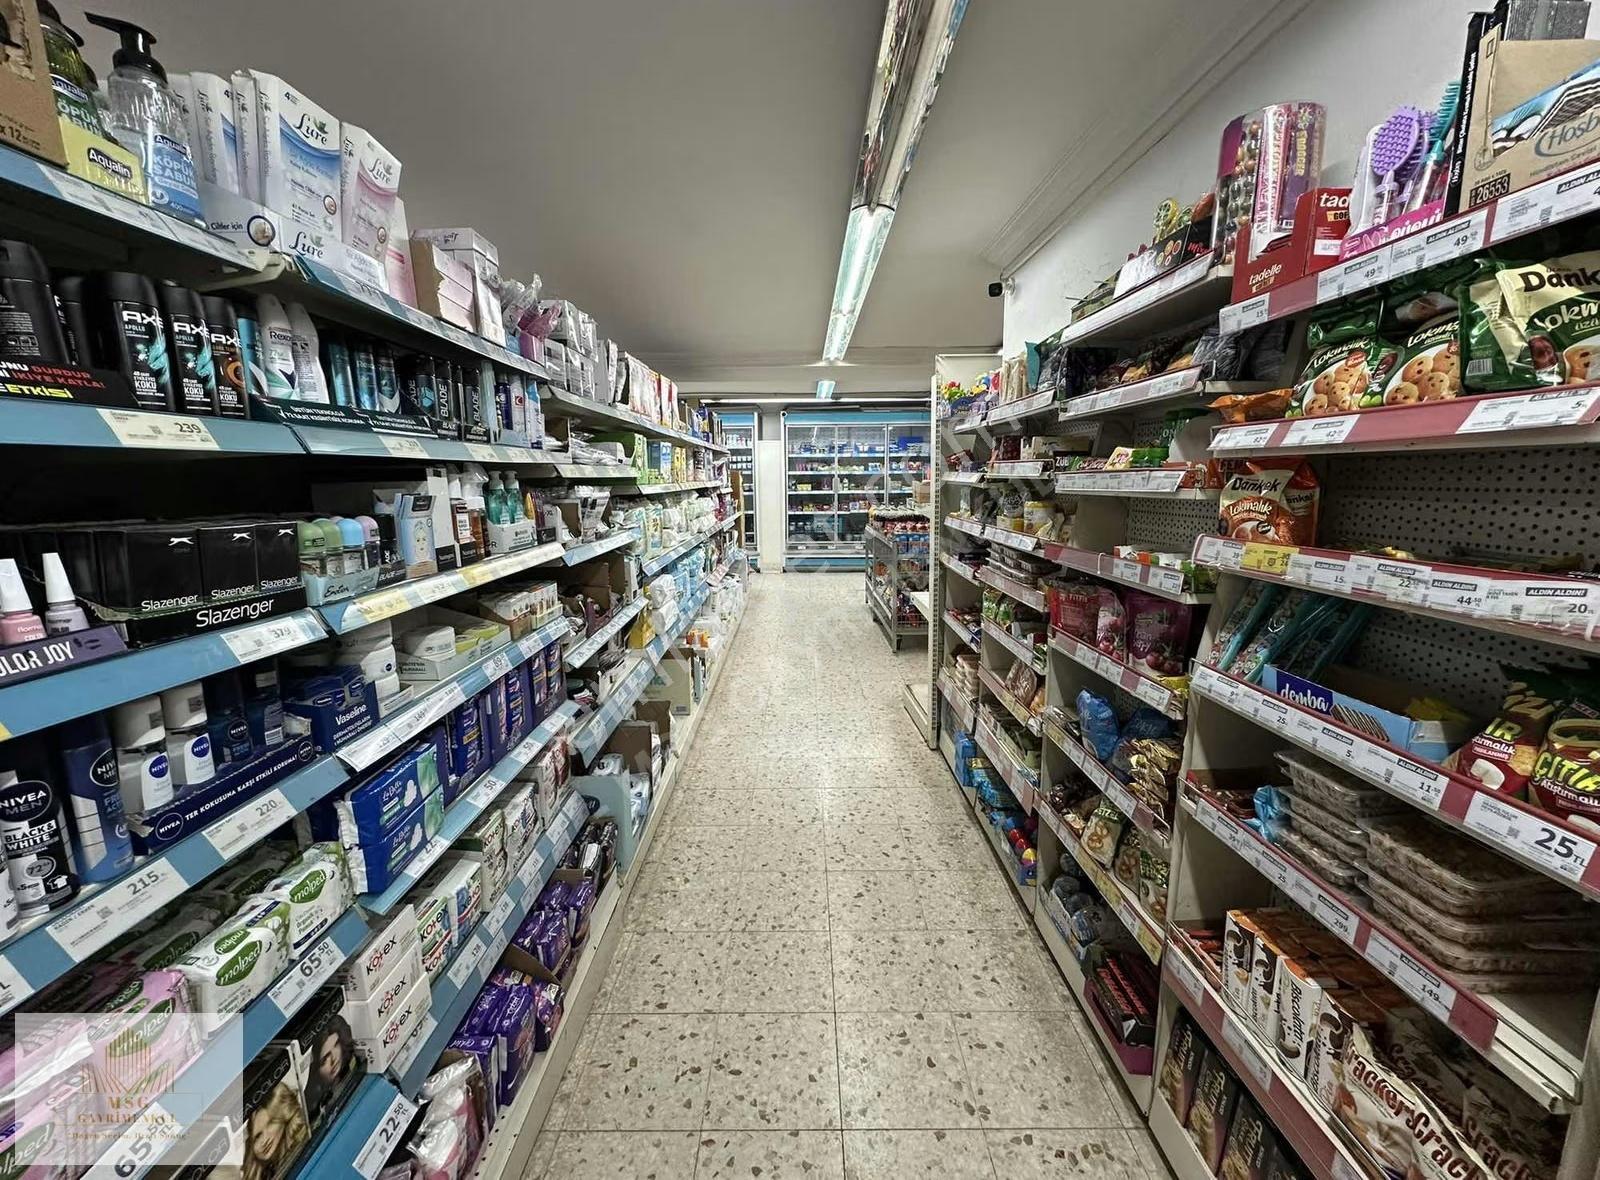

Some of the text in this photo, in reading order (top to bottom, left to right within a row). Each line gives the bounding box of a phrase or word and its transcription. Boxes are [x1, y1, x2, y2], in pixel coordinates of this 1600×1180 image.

[57, 99, 98, 129] ÖPÜK
[295, 113, 328, 146] Lure
[89, 149, 132, 178] Aqualin
[1476, 176, 1509, 203] 26553
[289, 231, 324, 259] Lure
[1454, 235, 1468, 247] 49
[1249, 264, 1282, 285] tadelle
[122, 310, 163, 329] AXE
[173, 321, 210, 338] AXE
[135, 381, 156, 389] KOKU
[441, 384, 449, 418] BLADE
[175, 423, 202, 433] 239
[211, 584, 255, 600] Slazenger
[261, 576, 298, 590] Slazenger
[1555, 589, 1586, 597] ALDIN!
[141, 595, 199, 611] Slazenger
[1457, 596, 1472, 606] 44
[1567, 603, 1588, 614] 20
[196, 599, 275, 628] Slazenger
[47, 641, 75, 664] JOY
[335, 704, 367, 726] Vaseline
[150, 762, 168, 772] NIVEA
[0, 790, 47, 809] NIVEA
[5, 801, 43, 816] MEN
[185, 811, 199, 822] TER
[200, 791, 236, 813] KOKUSUNA
[255, 799, 276, 816] 220
[159, 820, 180, 834] NIVEA
[7, 833, 50, 851] WHITE
[1534, 827, 1588, 867] 25 TL
[127, 870, 160, 895] 215
[292, 870, 327, 903] molped
[318, 941, 329, 953] 50
[219, 942, 262, 986] molped
[299, 953, 322, 979] 65
[1291, 981, 1306, 1043] Biscolata
[1346, 1046, 1416, 1128] rackers
[393, 1102, 405, 1116] 50
[379, 1117, 402, 1143] 22
[113, 1137, 152, 1179] 65
